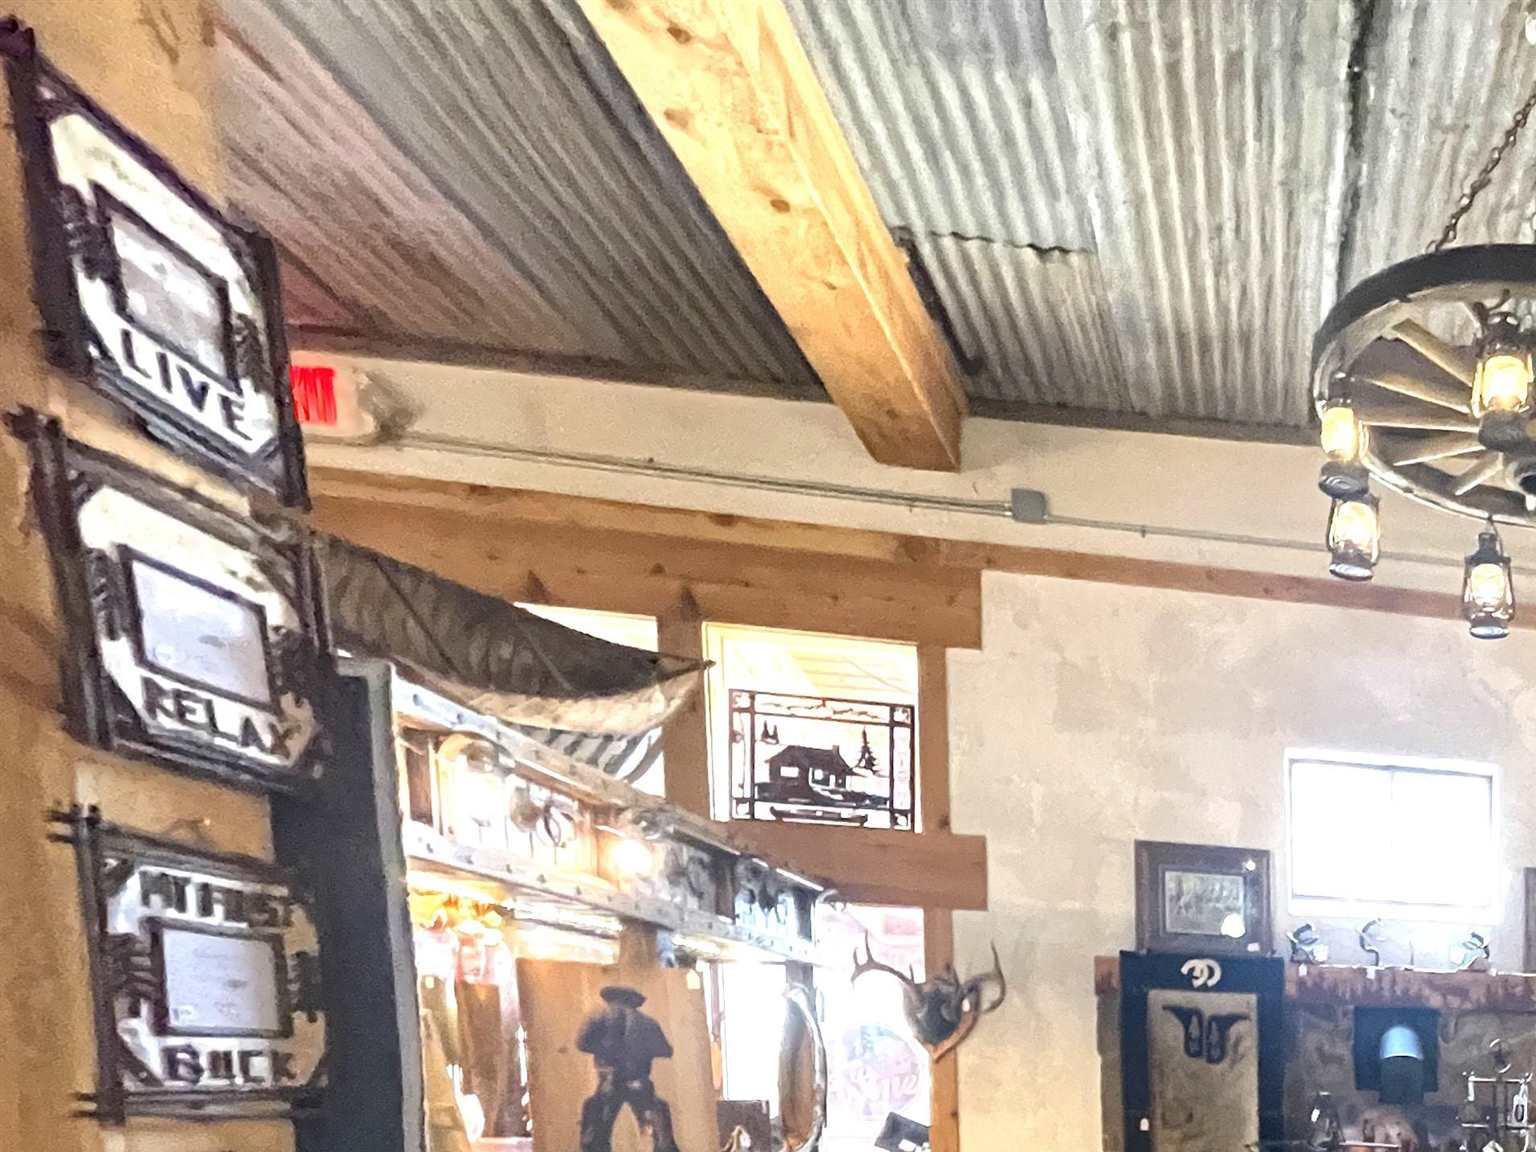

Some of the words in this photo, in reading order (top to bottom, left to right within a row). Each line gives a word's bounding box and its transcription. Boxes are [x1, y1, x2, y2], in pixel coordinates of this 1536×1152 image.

[119, 327, 254, 442] LIVE
[140, 674, 302, 761] RELAX
[160, 1043, 297, 1084] BUCK
